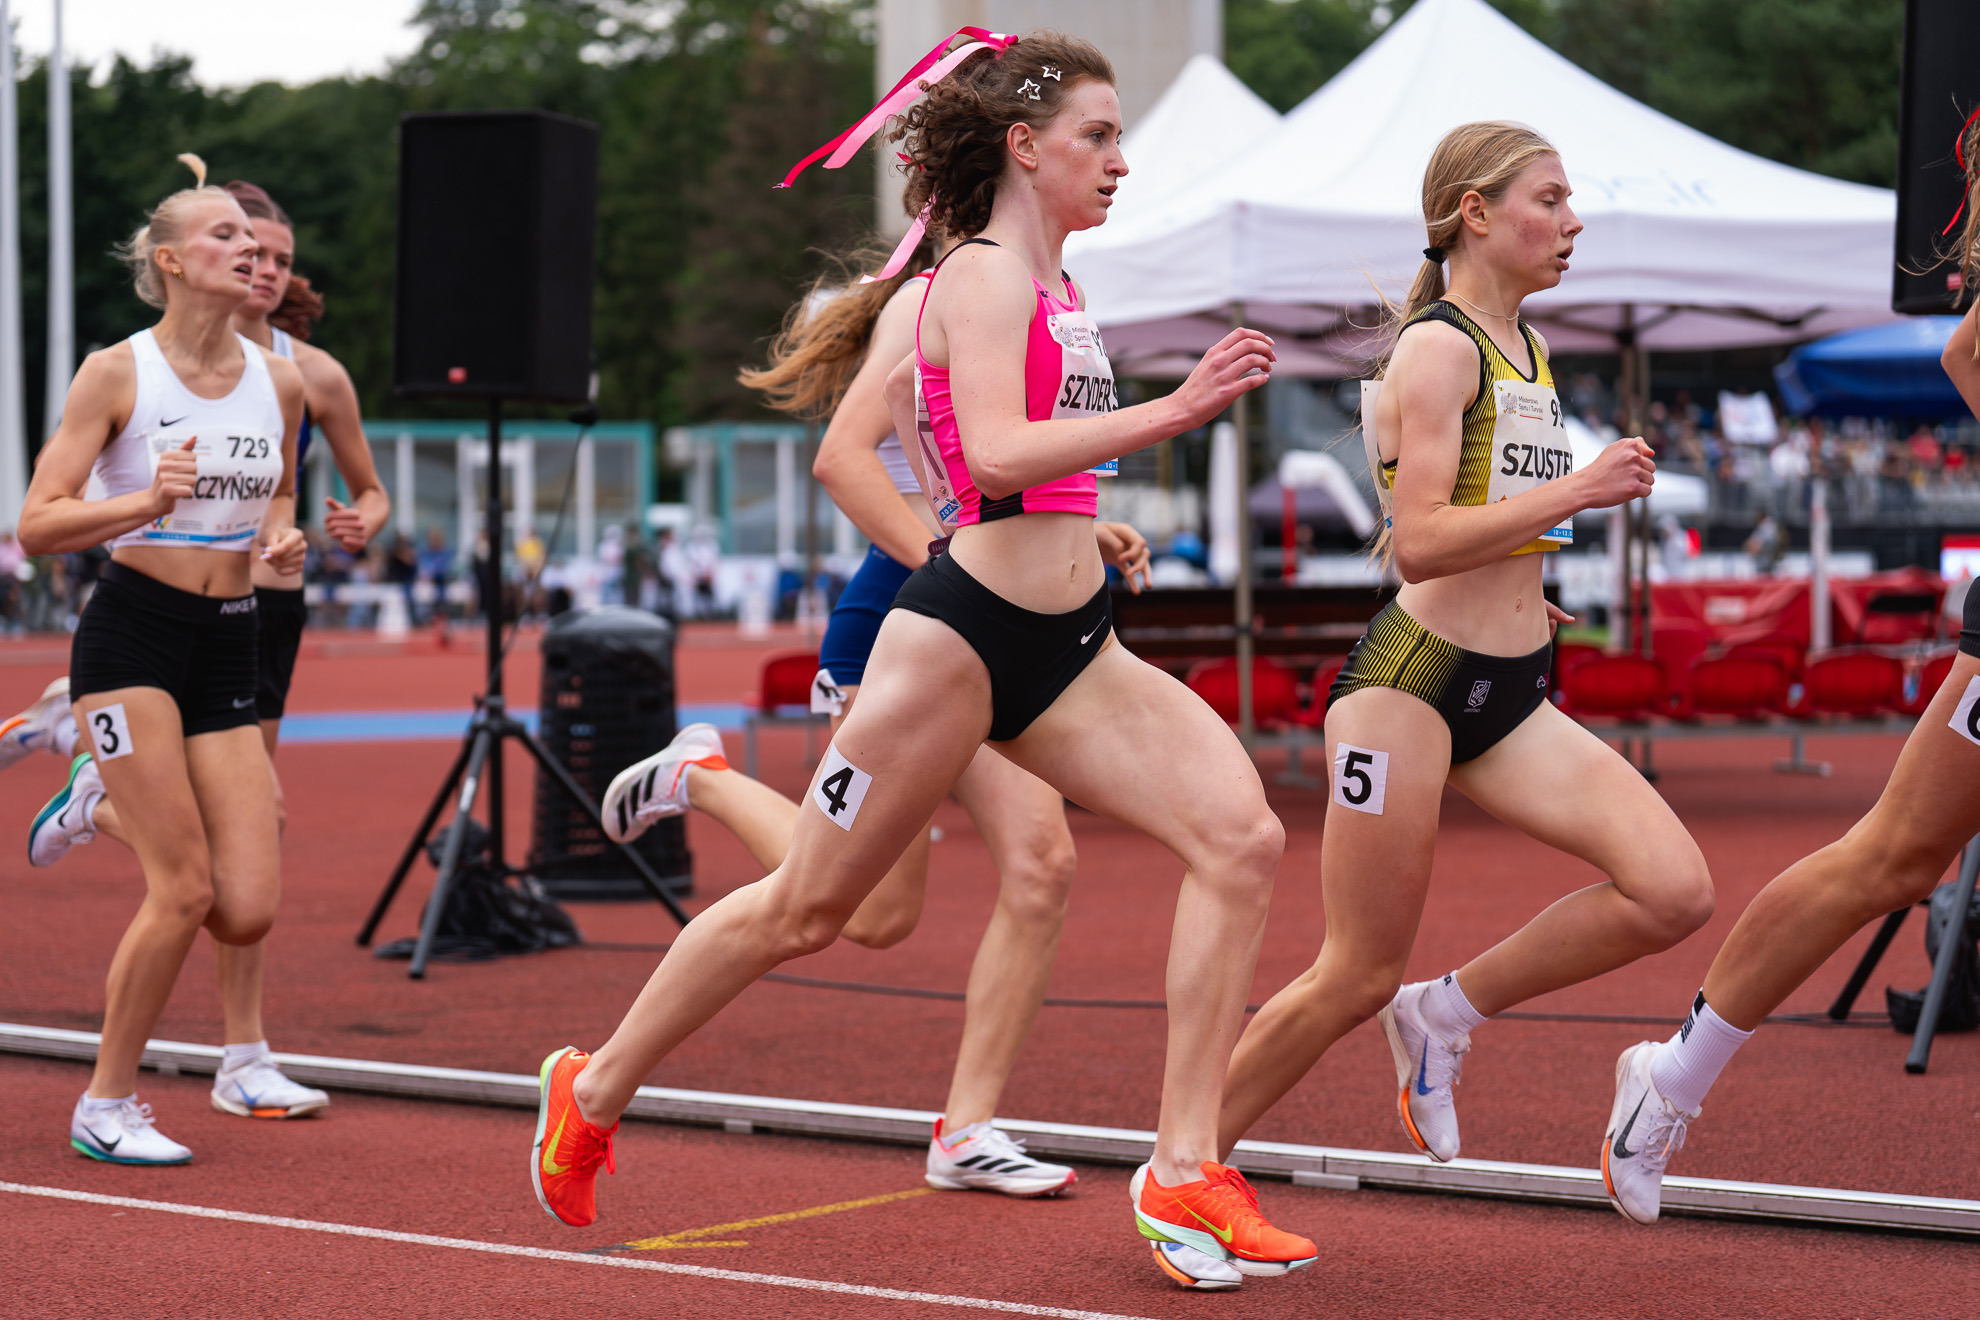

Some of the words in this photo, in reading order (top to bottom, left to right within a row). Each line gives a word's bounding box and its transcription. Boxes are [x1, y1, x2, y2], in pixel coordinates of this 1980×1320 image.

[227, 436, 269, 458] 729
[1500, 442, 1573, 480] SZUSTE
[181, 470, 273, 500] CZYŃSKA
[220, 597, 250, 615] NIKE
[94, 712, 120, 754] 3
[821, 765, 855, 817] 4
[1341, 750, 1373, 805] 5
